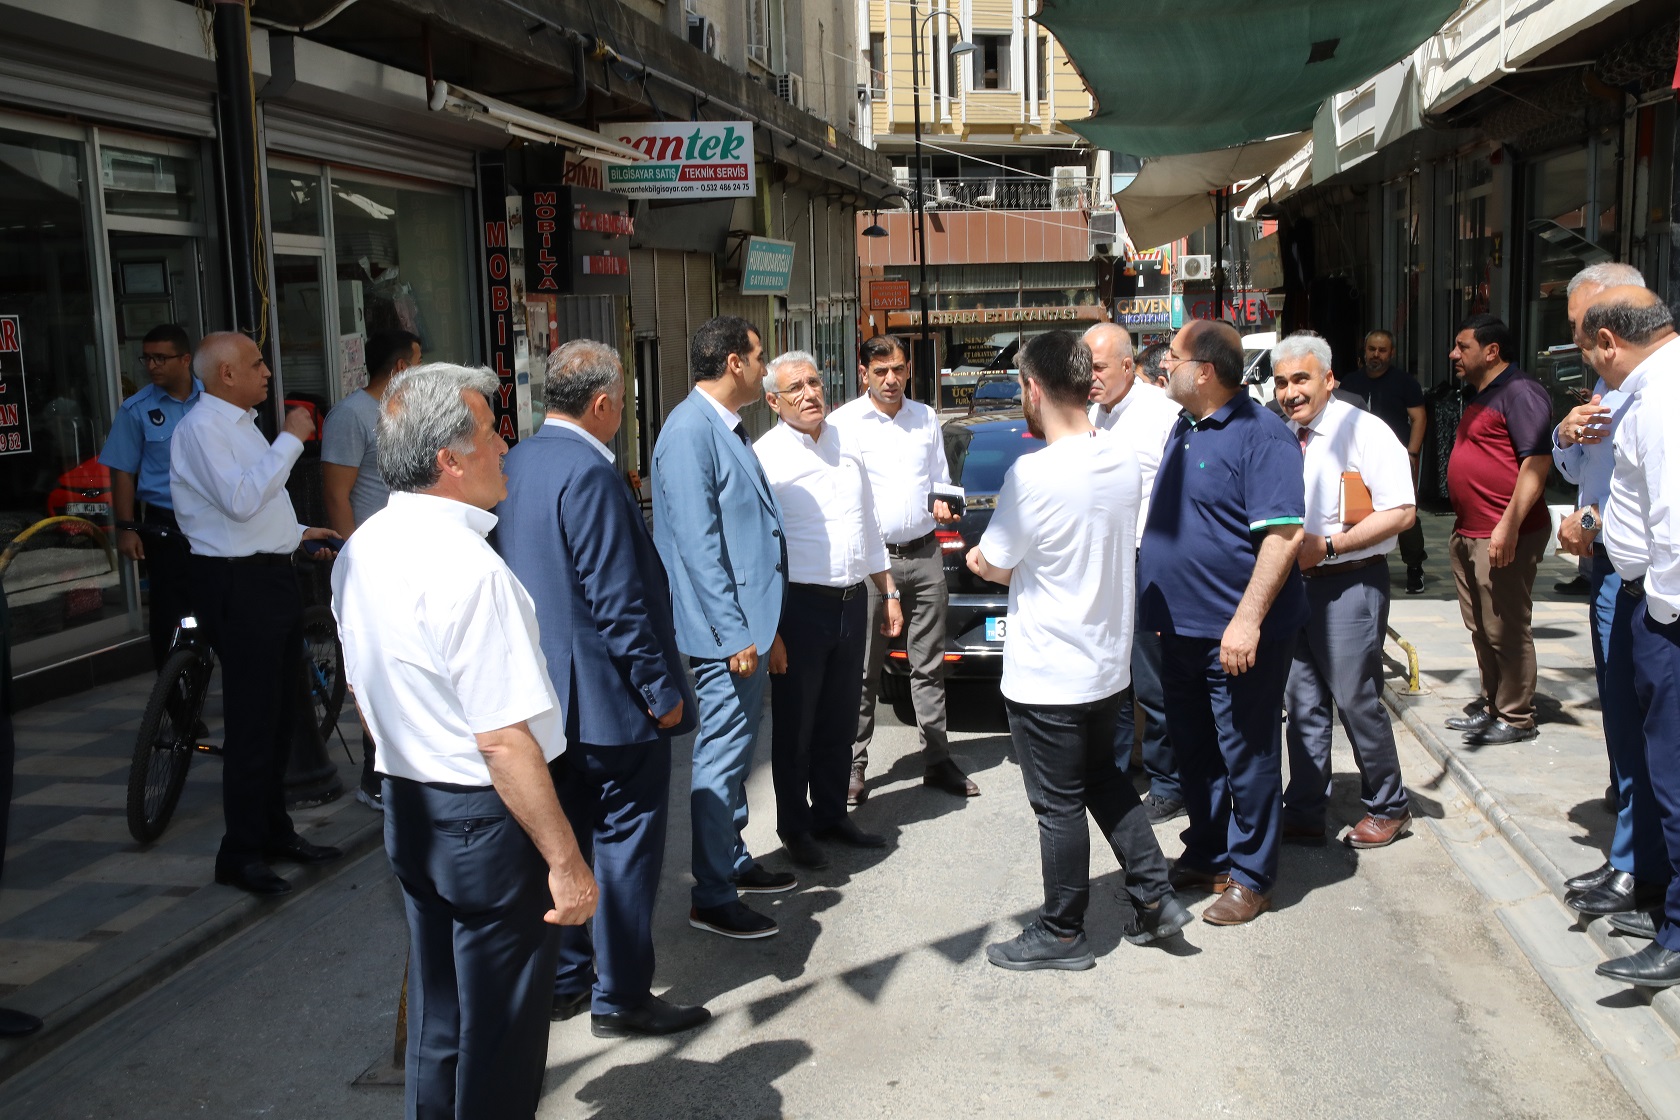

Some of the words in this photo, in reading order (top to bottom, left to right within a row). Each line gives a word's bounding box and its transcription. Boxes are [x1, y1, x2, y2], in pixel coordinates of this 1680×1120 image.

[611, 167, 654, 180] BİLGİSAYAR
[685, 165, 715, 179] TEKNİK
[716, 165, 746, 178] SERVİS
[610, 185, 694, 195] www.cantekbilgisayar.com
[719, 183, 731, 191] 486
[733, 183, 741, 191] 24
[534, 191, 558, 290] MOBİLYA
[985, 311, 1002, 323] ET
[486, 221, 516, 440] MOBİLYA
